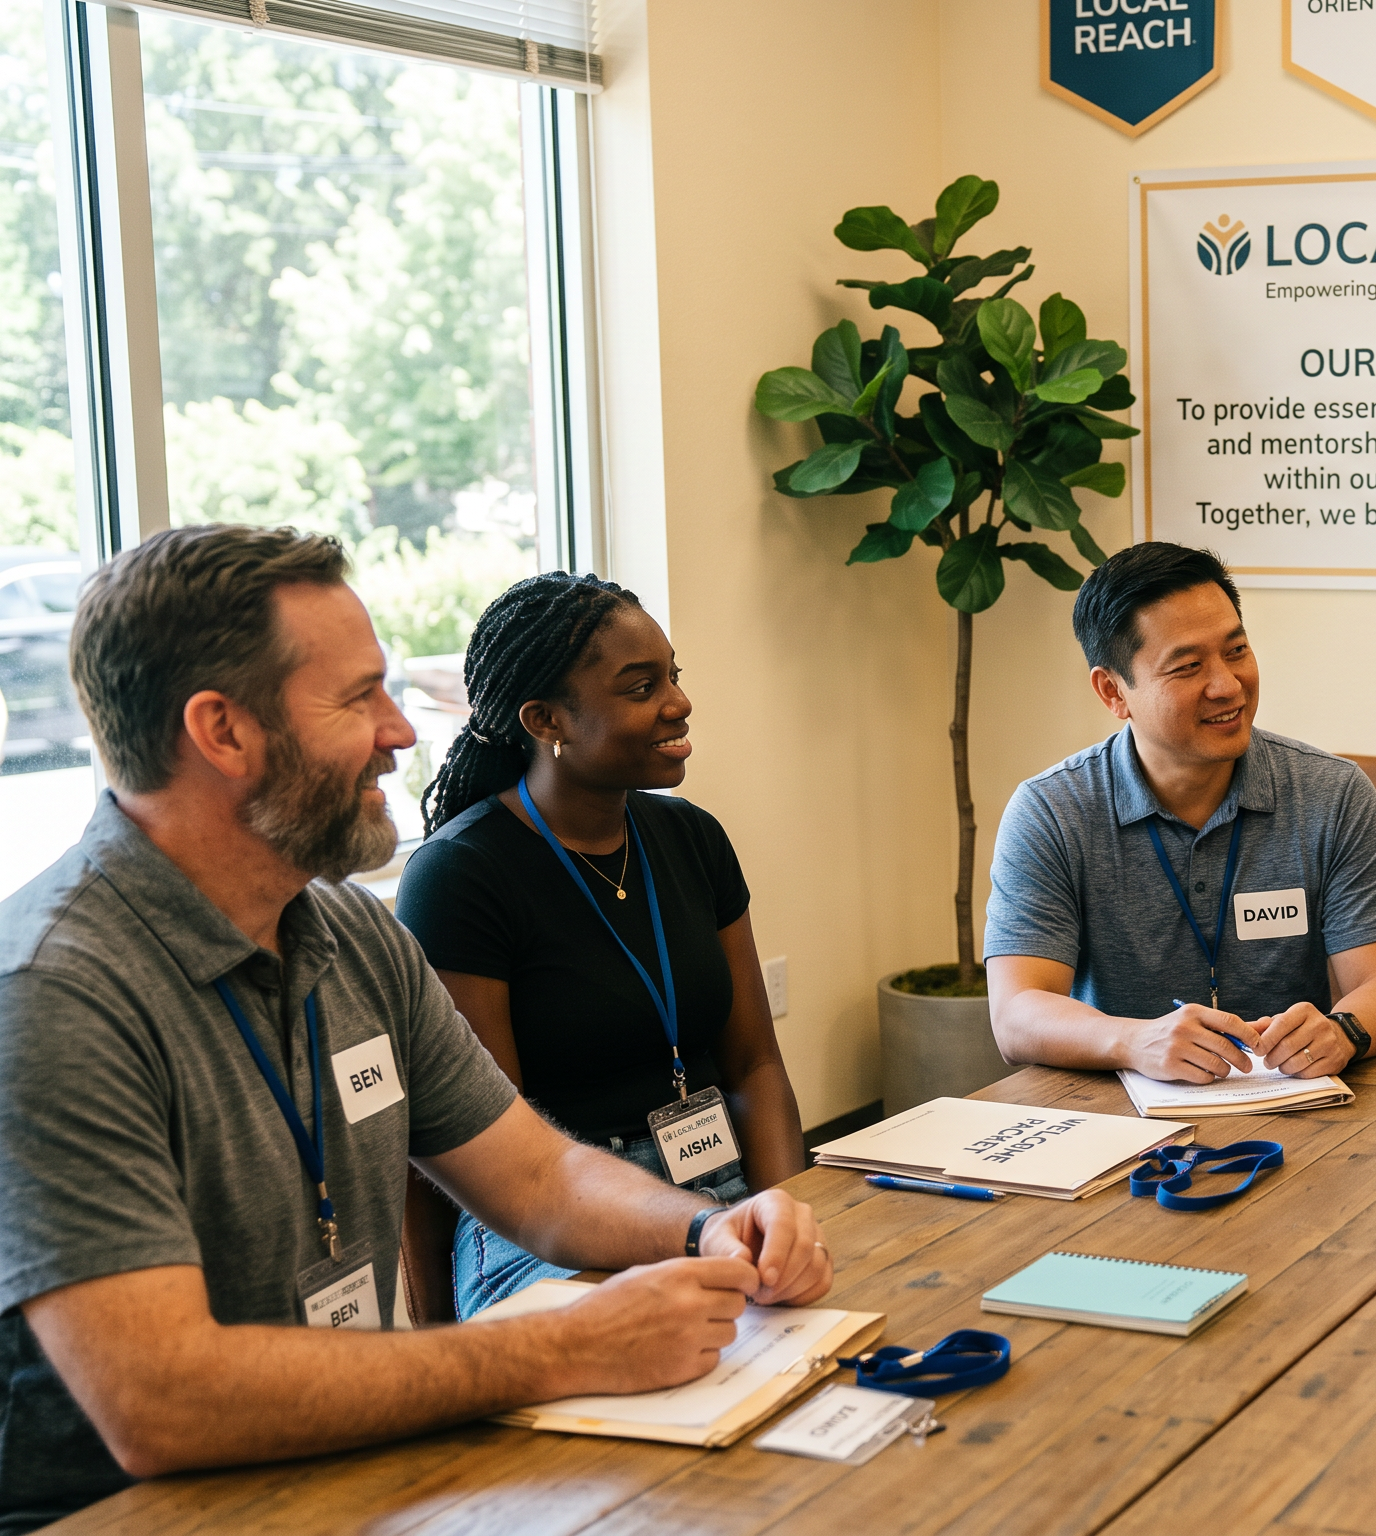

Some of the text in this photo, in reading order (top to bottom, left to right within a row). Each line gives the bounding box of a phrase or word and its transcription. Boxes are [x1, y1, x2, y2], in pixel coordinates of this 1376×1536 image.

[1300, 347, 1376, 378] OUR
[1176, 397, 1206, 421] To
[1213, 396, 1306, 426] provide
[1207, 431, 1252, 456] and
[1263, 466, 1341, 490] within
[1195, 501, 1311, 531] Together,
[1319, 508, 1356, 526] we
[1243, 905, 1299, 922] DAVID
[349, 1064, 384, 1093] BEN
[679, 1132, 723, 1162] AISHA
[962, 1118, 1047, 1154] PACKET
[982, 1118, 1087, 1164] WELCOME
[330, 1299, 359, 1328] BEN
